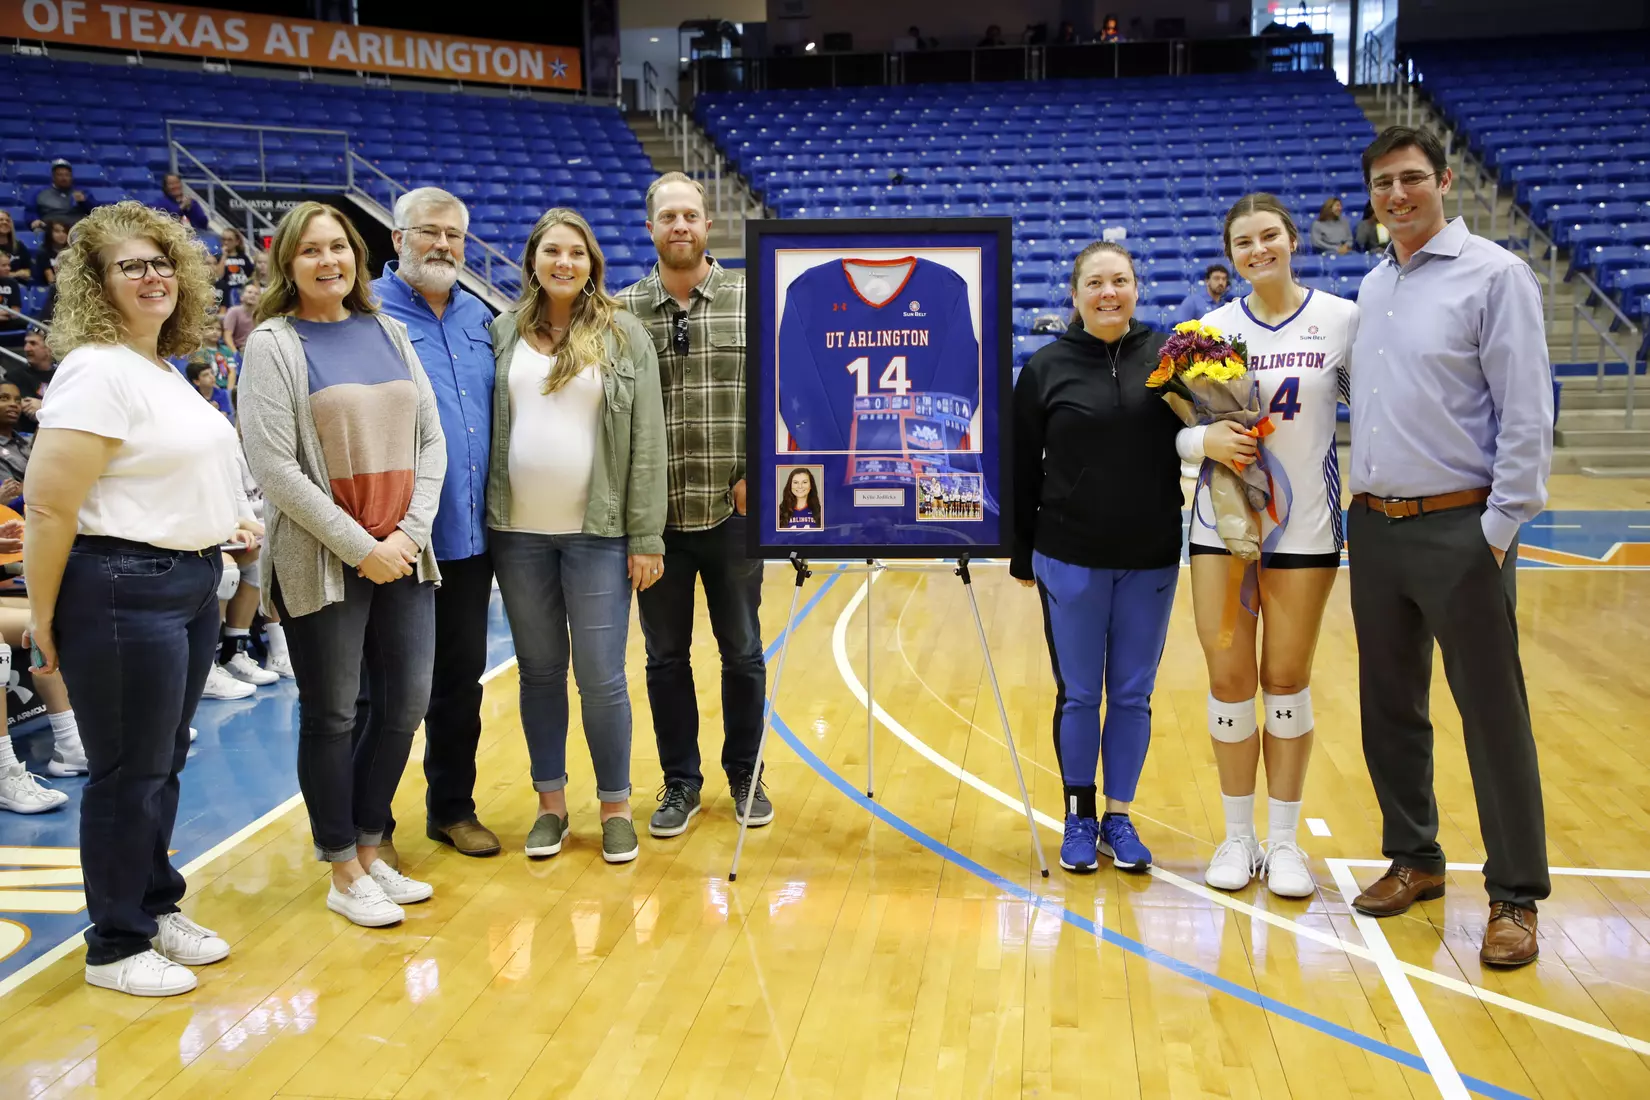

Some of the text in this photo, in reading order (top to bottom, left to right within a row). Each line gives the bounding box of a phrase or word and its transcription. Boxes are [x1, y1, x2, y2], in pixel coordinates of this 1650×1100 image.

[22, 0, 545, 80] OF TEXAS AT ARLINGTON
[826, 330, 929, 348] UT ARLINGTON
[1249, 352, 1326, 371] RLINGTON
[846, 356, 912, 395] 14
[17, 704, 47, 721] ARMOU
